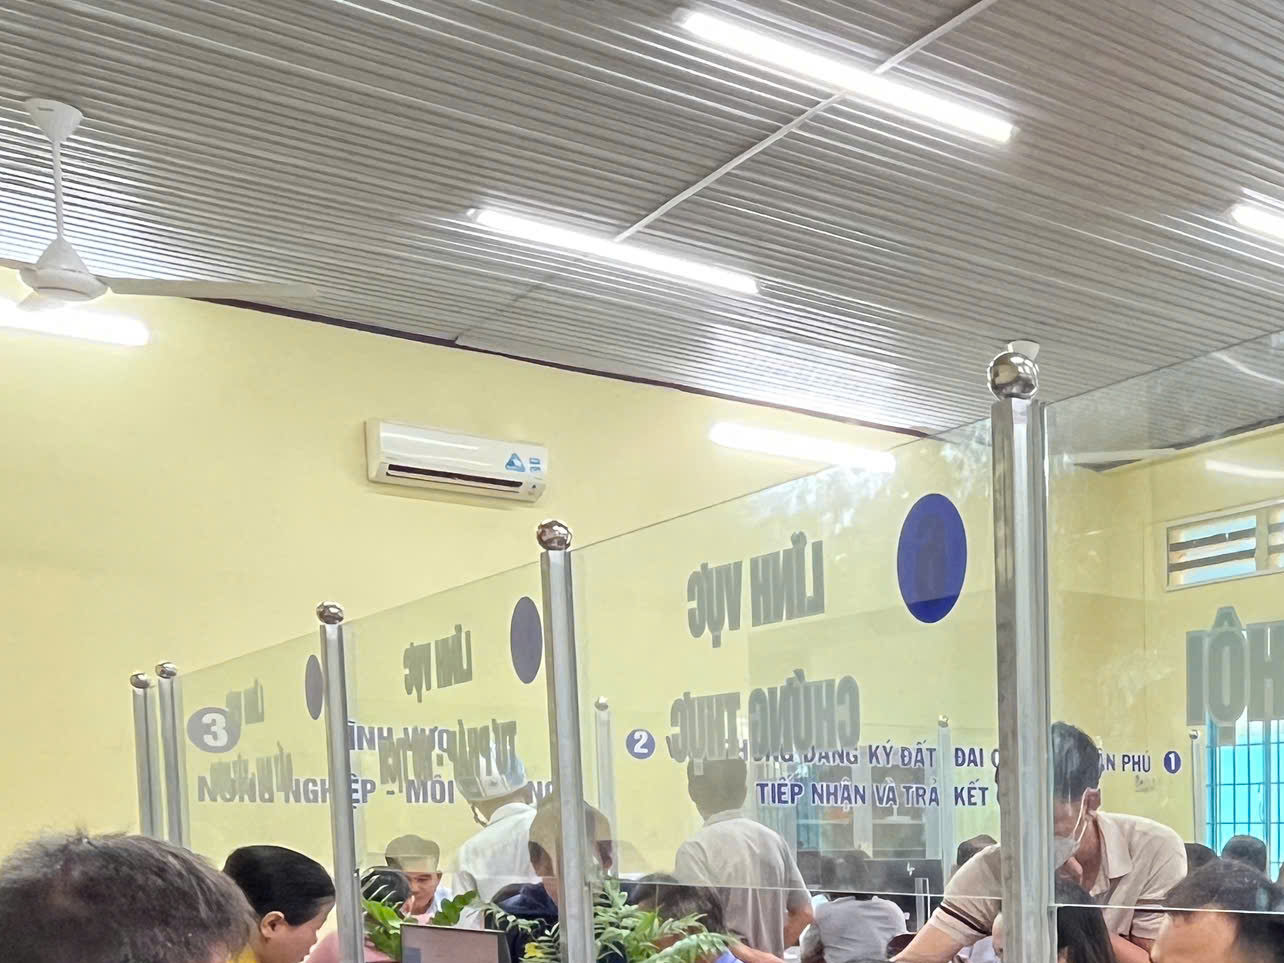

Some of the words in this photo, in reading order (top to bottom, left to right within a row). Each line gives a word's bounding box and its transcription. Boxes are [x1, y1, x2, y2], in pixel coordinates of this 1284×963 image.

[201, 712, 229, 747] 3
[868, 739, 893, 766] KÝ
[900, 739, 937, 768] ĐẤT
[954, 747, 984, 768] ĐAI
[756, 775, 803, 804] TIẾP
[811, 777, 866, 810] NHẬN
[875, 777, 898, 806] VÀ
[902, 778, 940, 806] TRẢ
[954, 778, 989, 806] KẾT
